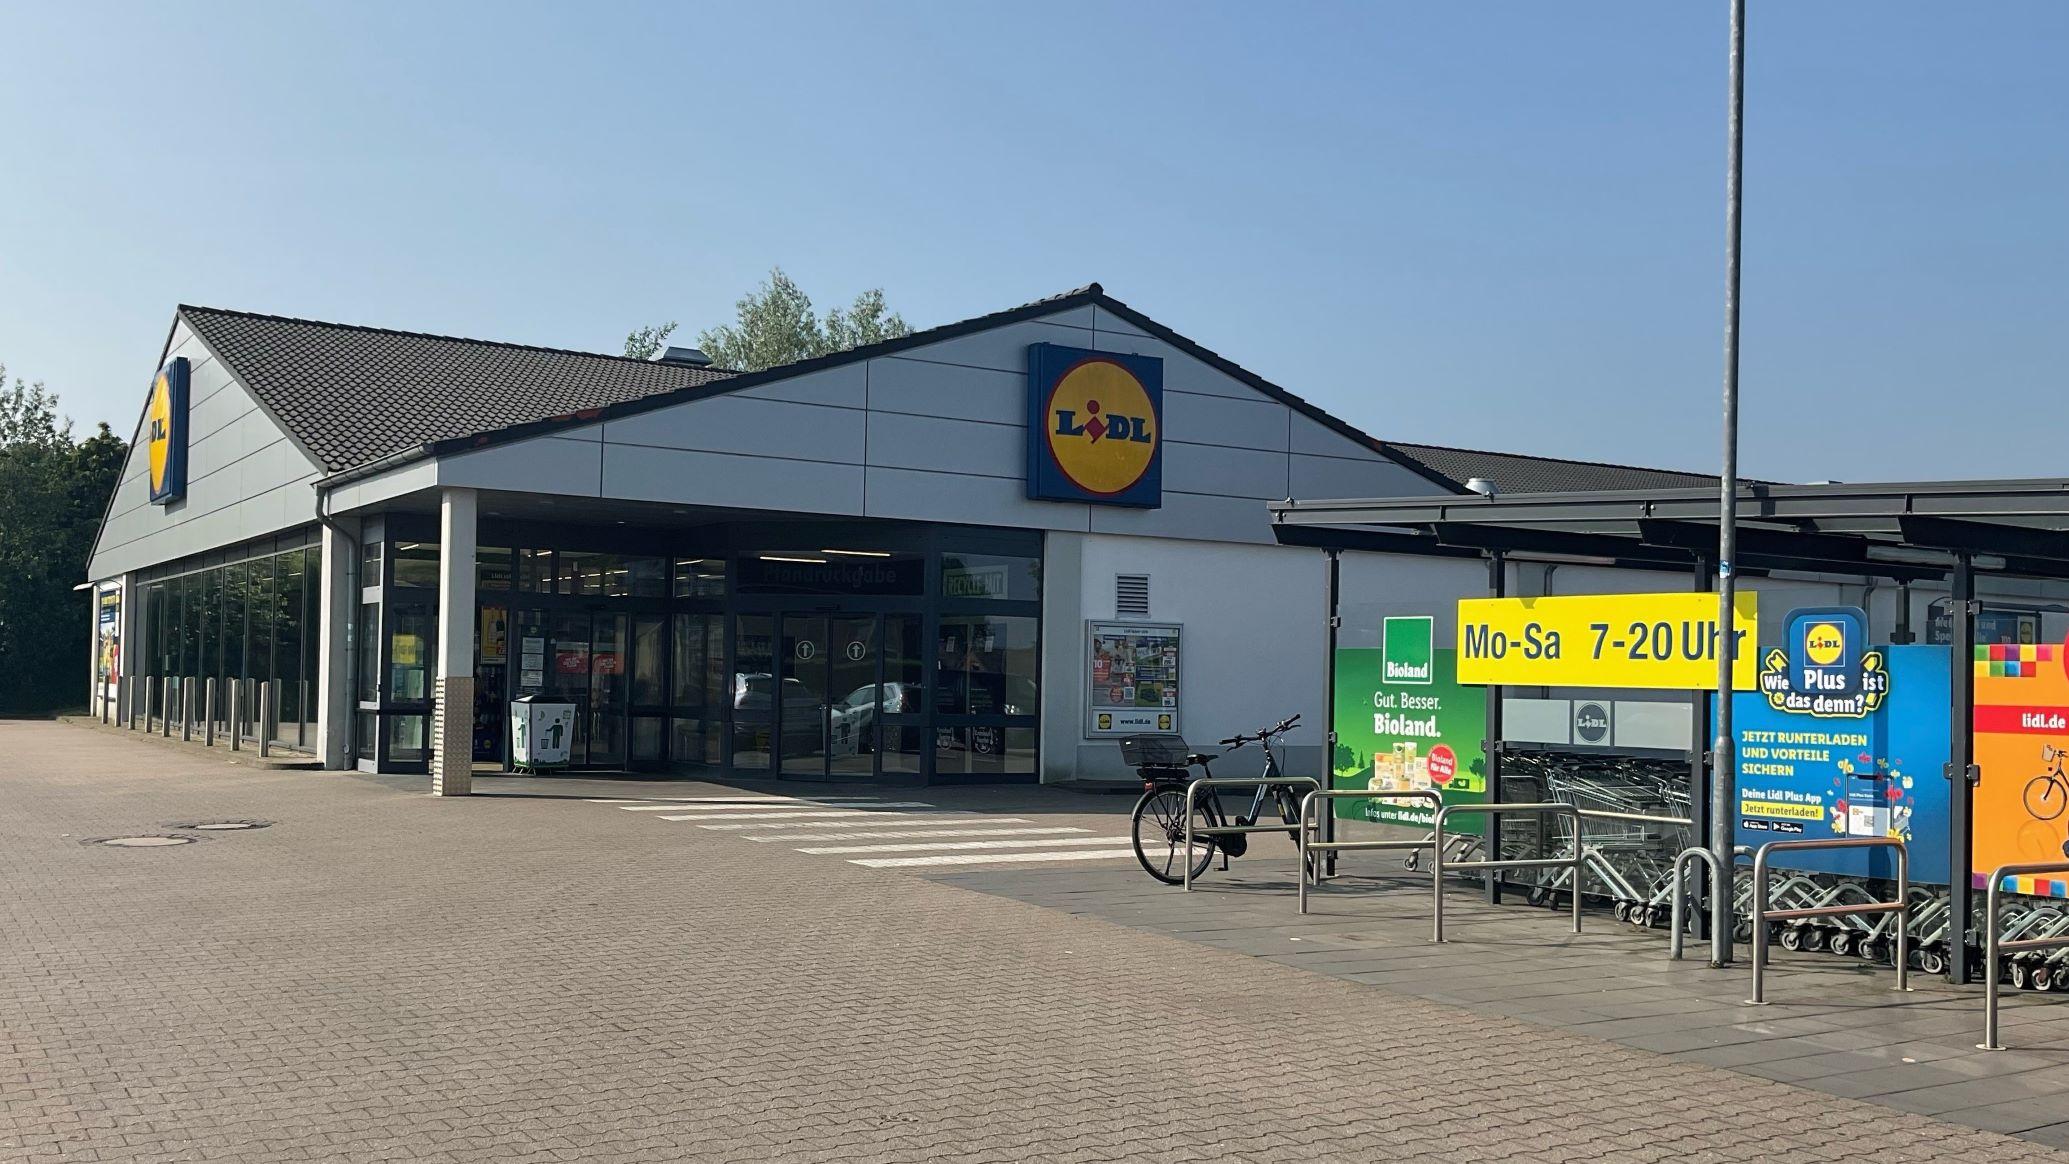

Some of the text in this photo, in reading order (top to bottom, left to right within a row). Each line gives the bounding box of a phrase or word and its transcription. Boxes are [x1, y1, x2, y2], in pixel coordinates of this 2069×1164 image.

[1056, 400, 1152, 444] LIDL
[1465, 623, 1561, 660] Mo-Sa
[1590, 622, 1673, 661] 7-20
[1809, 637, 1841, 649] LIDL
[1387, 661, 1428, 678] Bioland
[1764, 669, 1884, 691] Wie Plus ist
[1374, 691, 1442, 710] Gut. Besser.
[1786, 692, 1865, 713] das denn?
[1374, 713, 1442, 737] Bioland.
[1577, 714, 1607, 729] LIDL
[2022, 713, 2066, 728] lidl.de
[1742, 731, 1867, 746] JETZT RUNTERLADEN
[1742, 747, 1830, 761] UND VORTEILE
[1742, 763, 1794, 776] SICHERN
[1741, 788, 1822, 804] Deine Lidl Plus App
[1365, 807, 1380, 817] Infos
[1381, 810, 1397, 820] unter
[1745, 804, 1819, 817] Jetzt runterladen!
